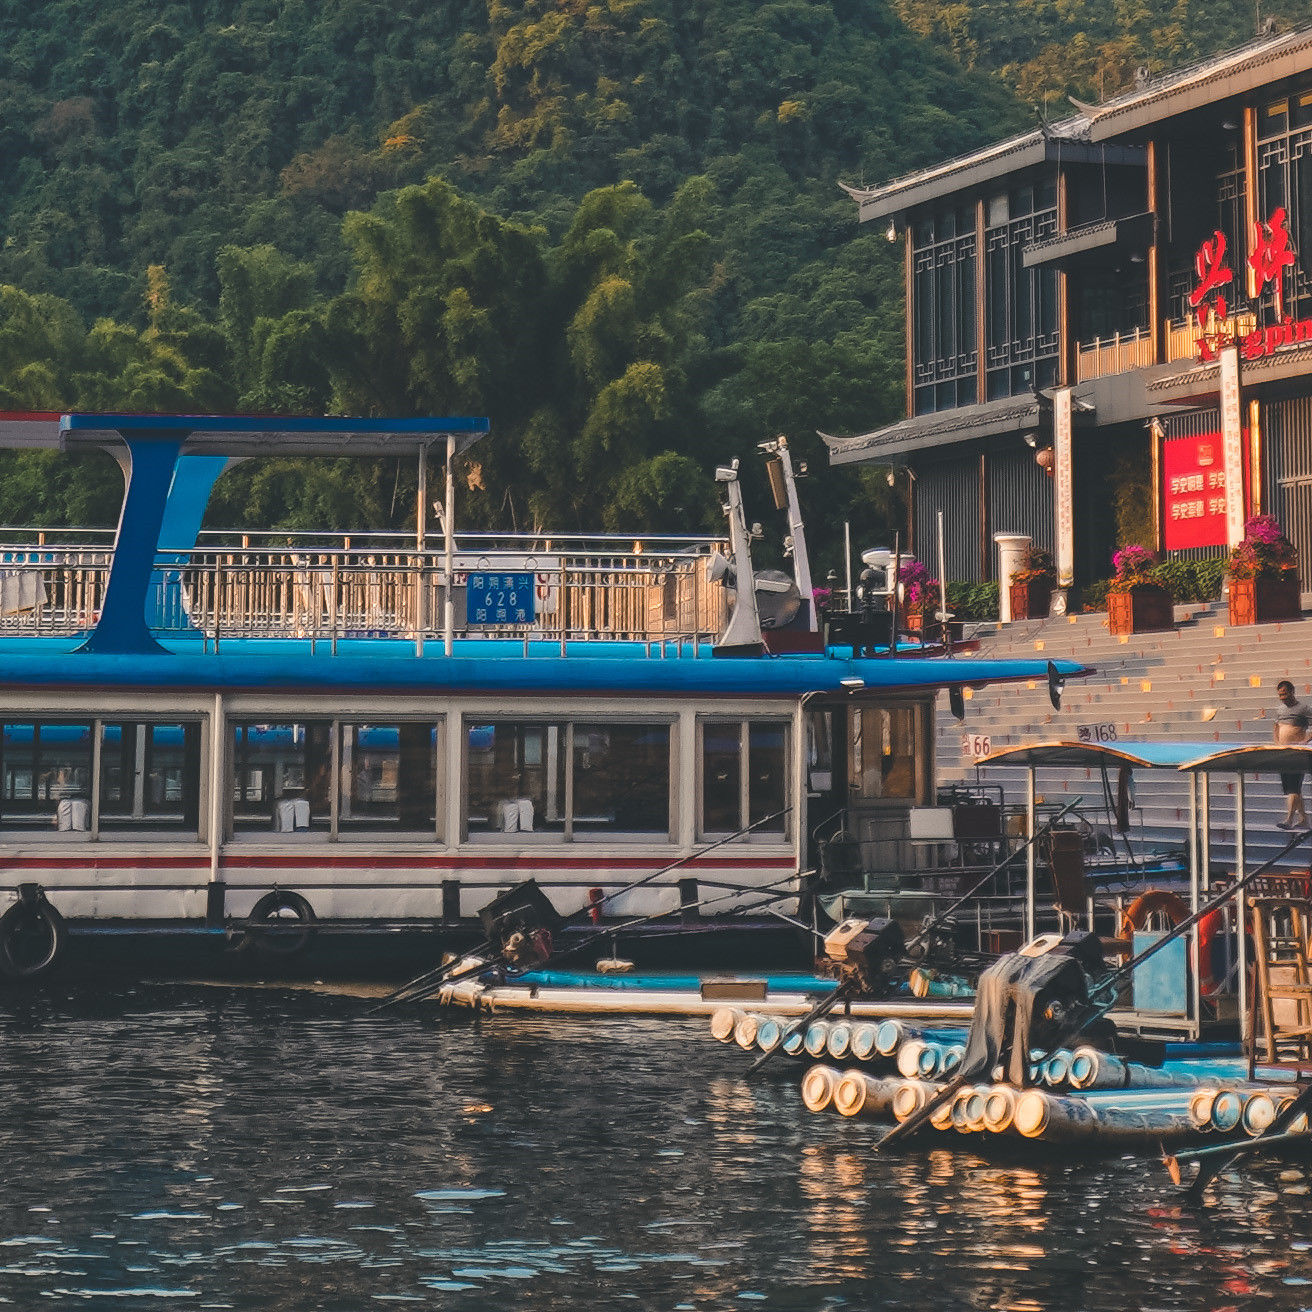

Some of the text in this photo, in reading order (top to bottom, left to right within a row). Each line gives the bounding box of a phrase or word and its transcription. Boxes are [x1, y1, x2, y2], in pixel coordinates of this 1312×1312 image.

[485, 591, 517, 606] 628
[476, 608, 526, 622] 阳朔港
